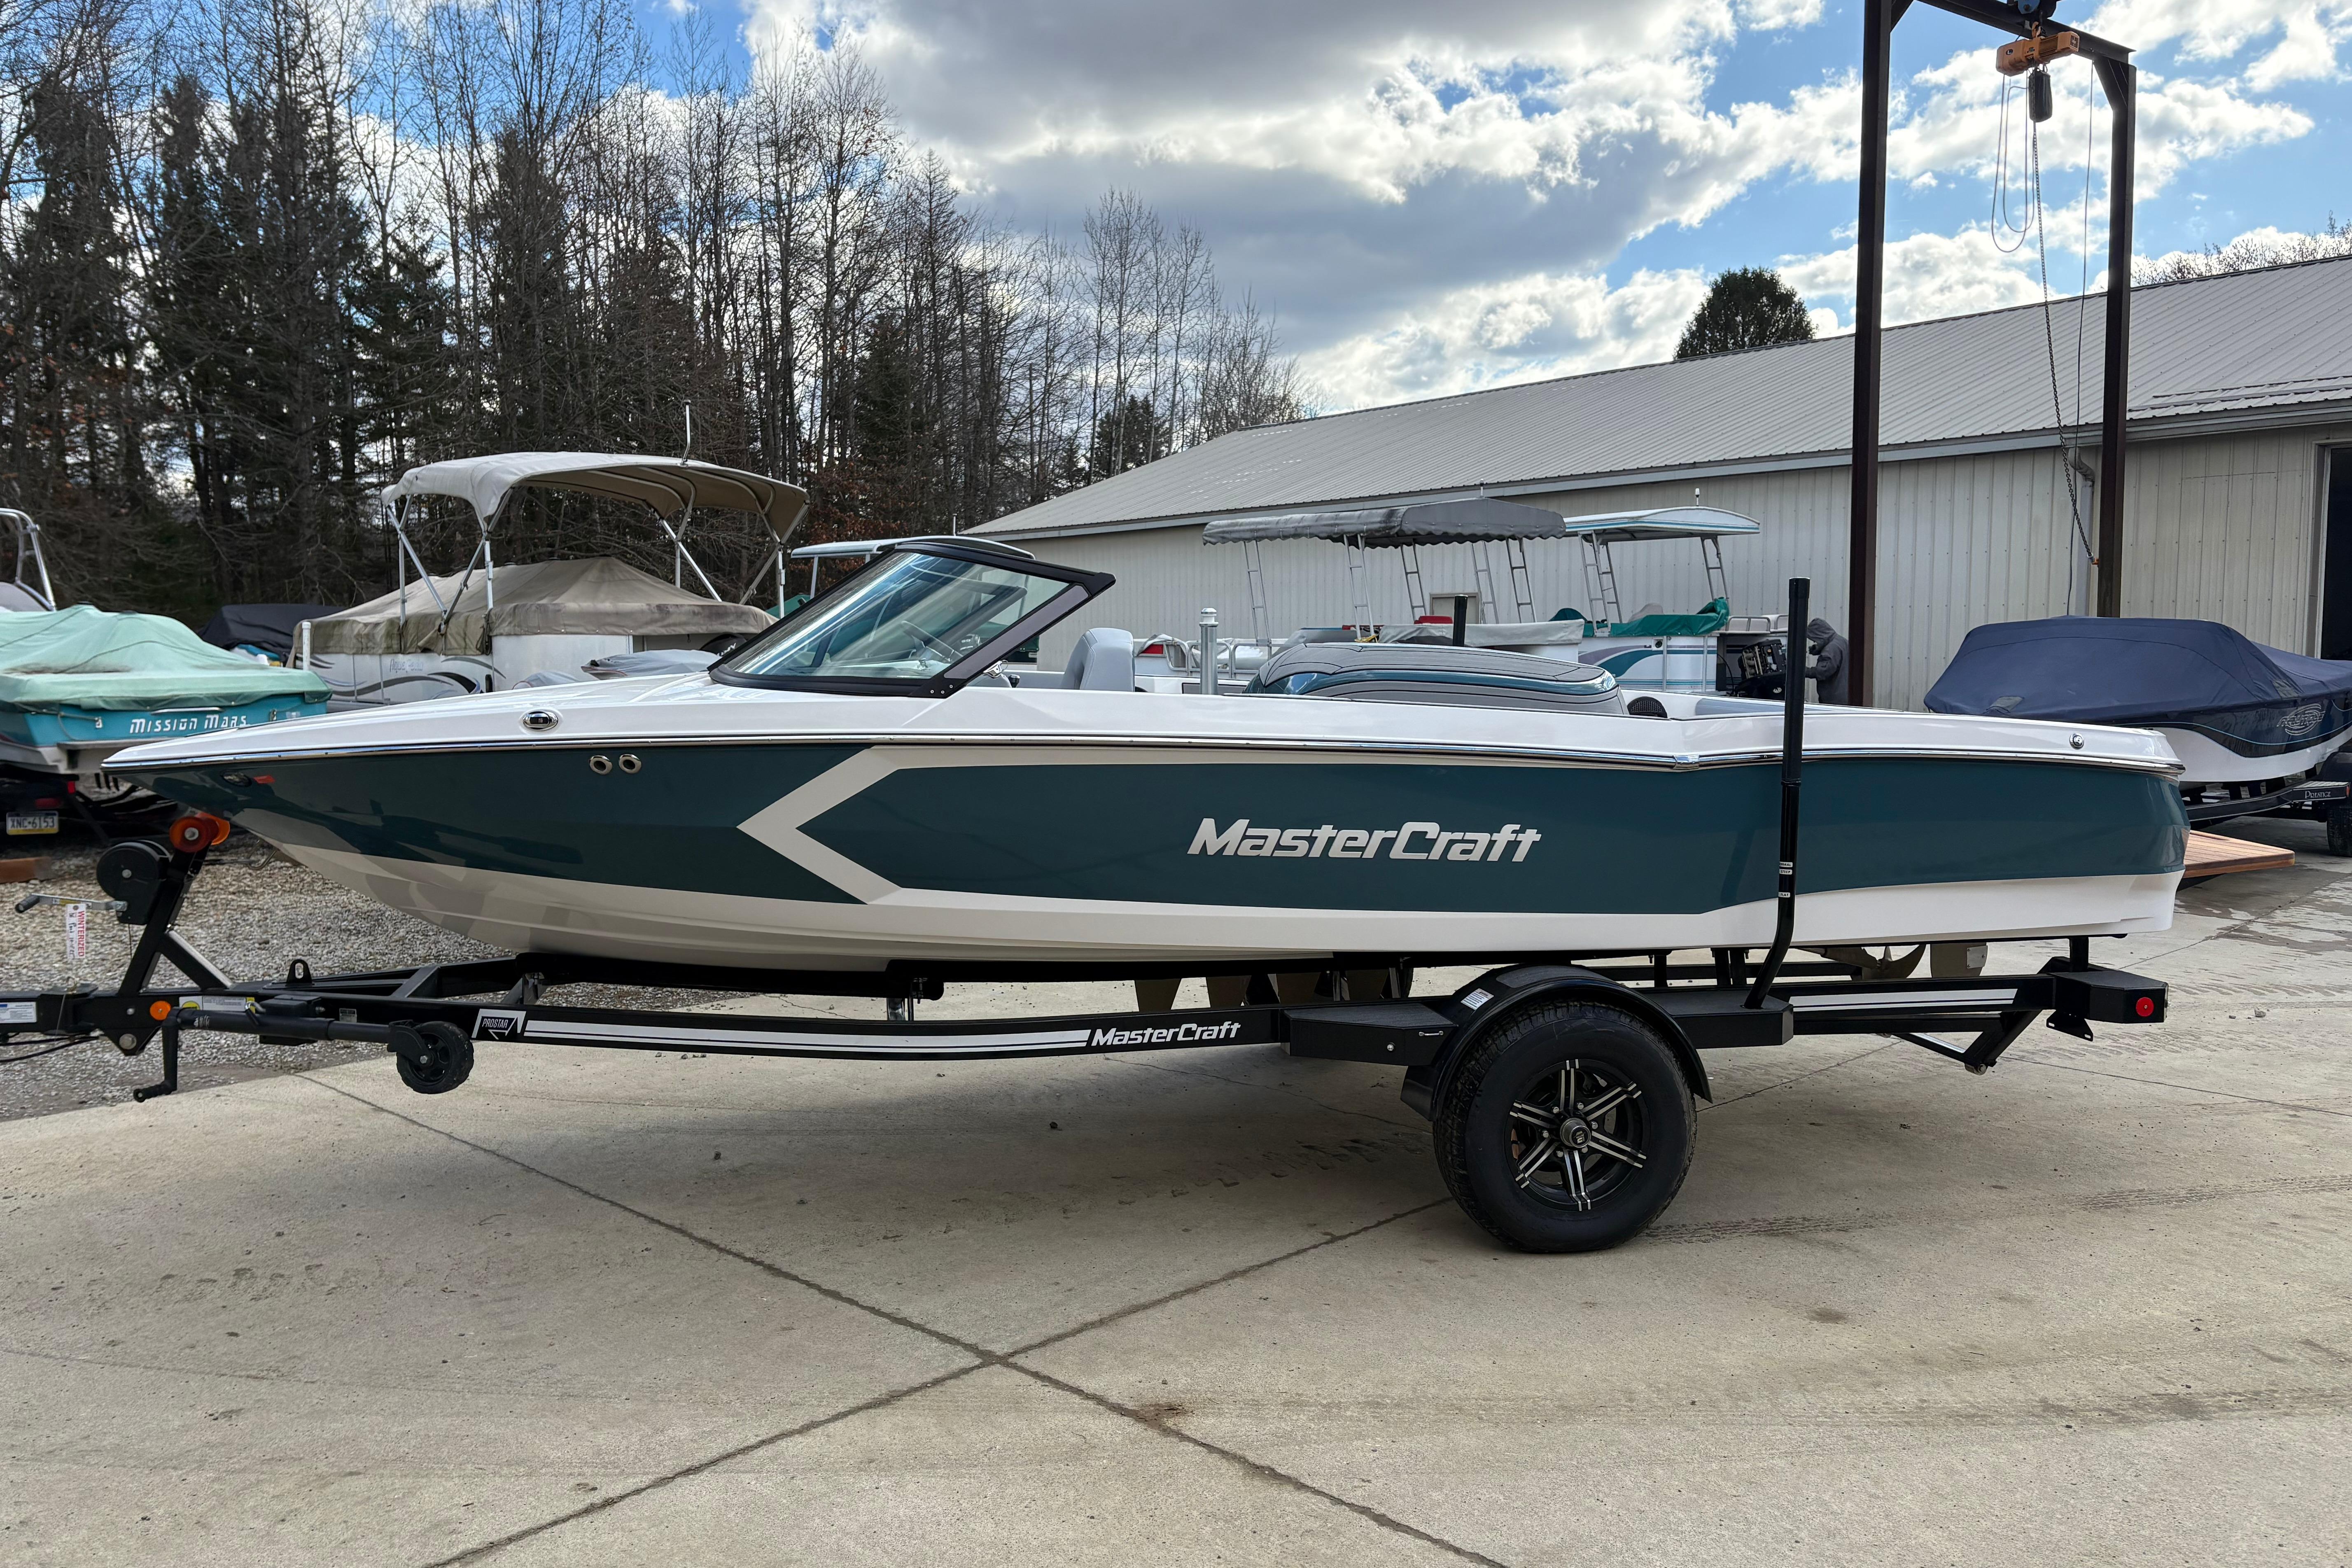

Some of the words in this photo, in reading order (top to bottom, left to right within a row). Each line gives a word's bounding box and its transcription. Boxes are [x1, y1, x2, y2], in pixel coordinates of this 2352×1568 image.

[1187, 818, 1542, 862] MasterCraft
[481, 1018, 509, 1029] PROSTAR
[1091, 1021, 1241, 1047] MasterCraft
